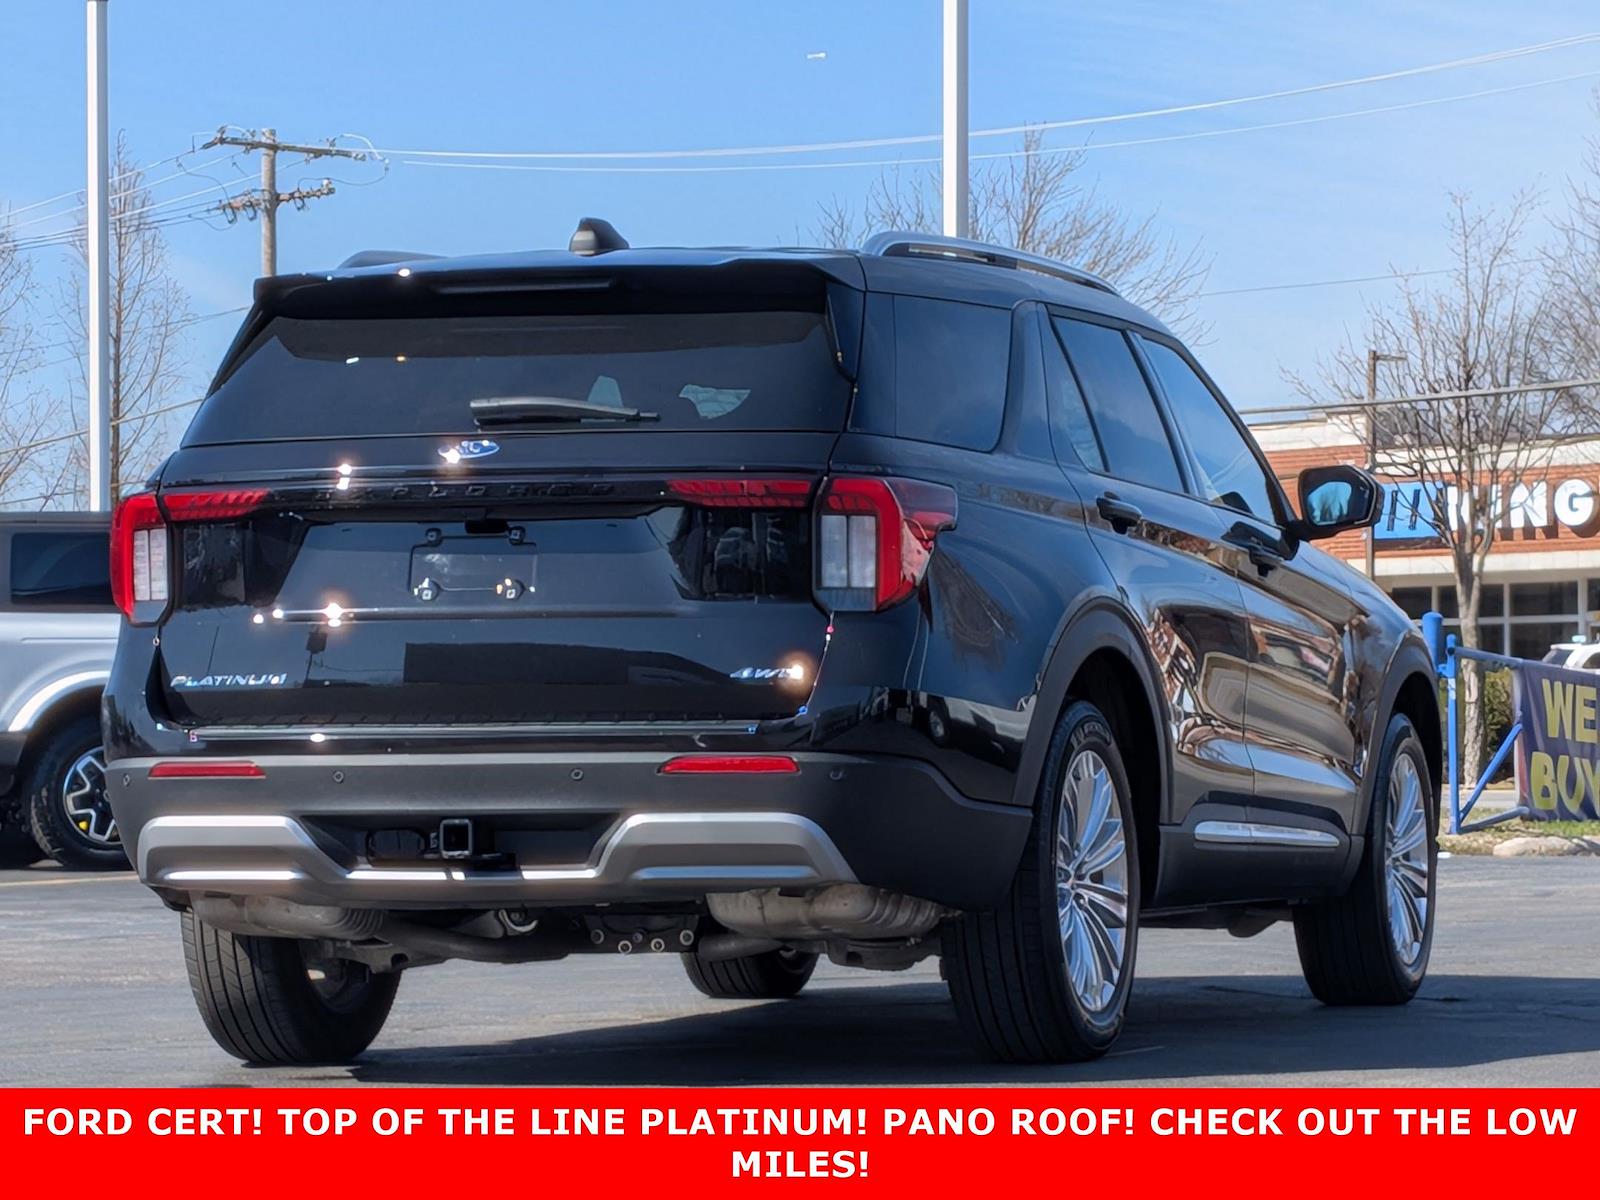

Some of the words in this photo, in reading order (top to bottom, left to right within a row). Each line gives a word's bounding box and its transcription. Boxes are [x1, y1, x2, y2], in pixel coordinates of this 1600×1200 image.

[170, 672, 288, 687] PLATINUM
[1541, 678, 1598, 744] WE
[1530, 750, 1600, 818] BUY
